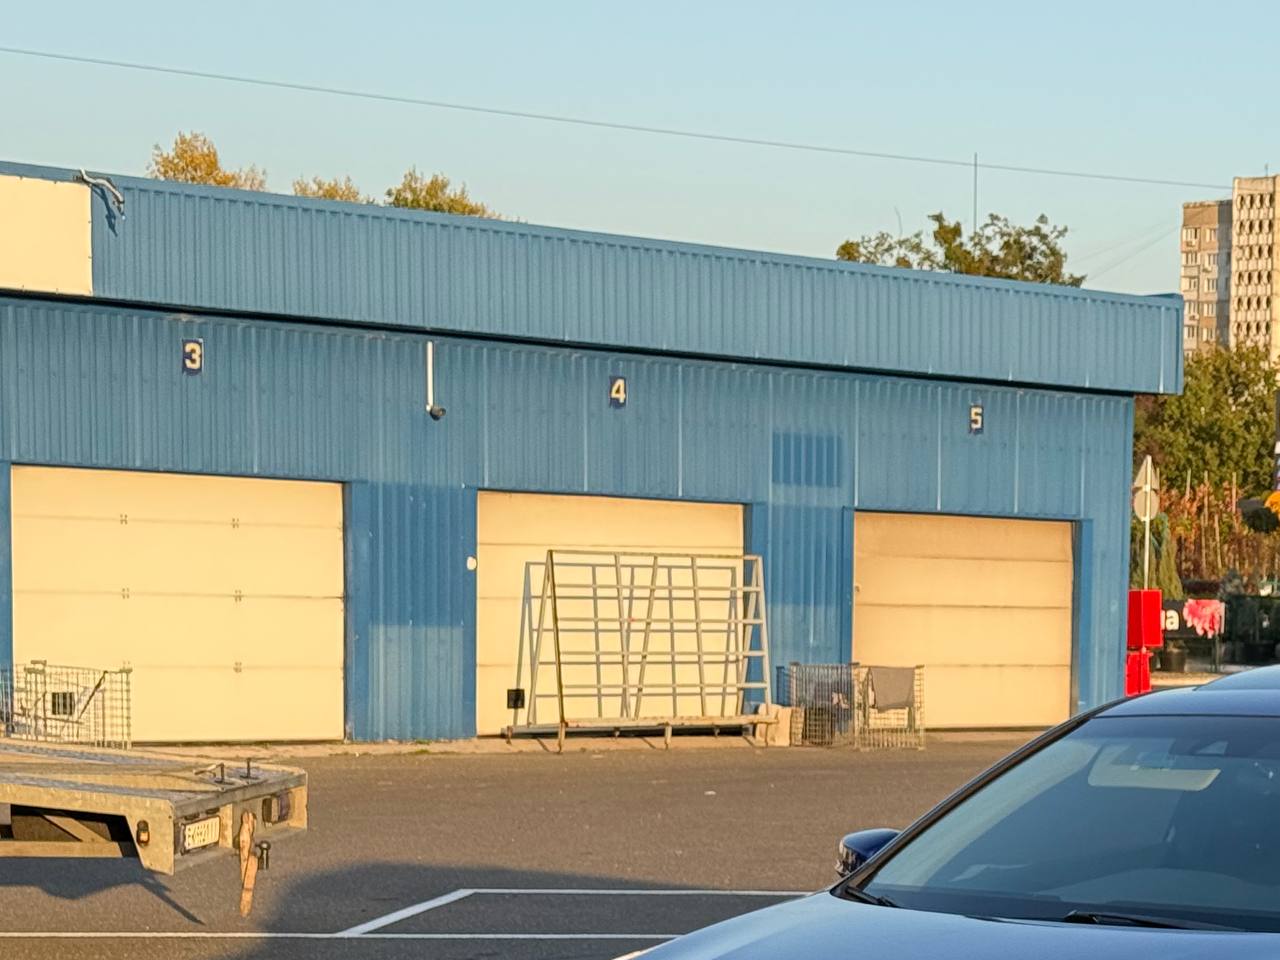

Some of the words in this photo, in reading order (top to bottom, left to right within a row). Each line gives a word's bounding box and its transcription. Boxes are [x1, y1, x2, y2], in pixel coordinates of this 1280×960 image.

[185, 342, 201, 370] 3
[611, 379, 625, 403] 4
[971, 407, 982, 428] 5
